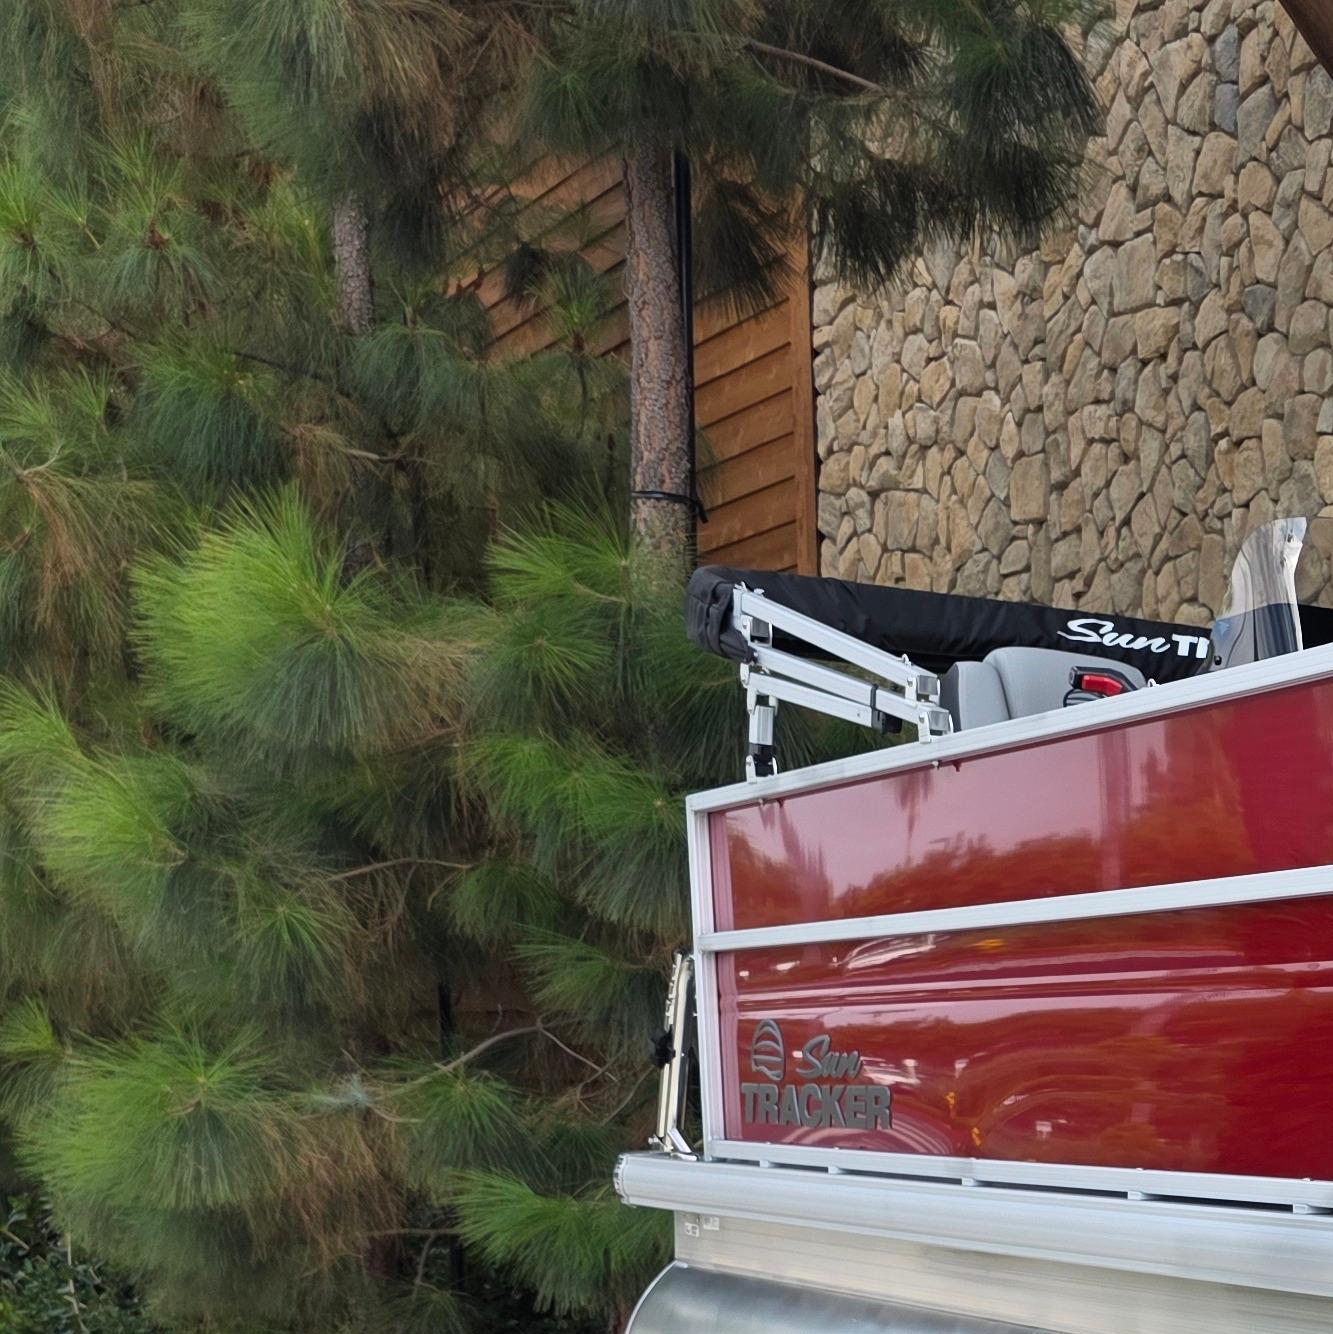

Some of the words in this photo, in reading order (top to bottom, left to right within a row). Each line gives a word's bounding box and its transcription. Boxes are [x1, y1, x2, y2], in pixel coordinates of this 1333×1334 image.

[1056, 618, 1171, 654] Sun
[795, 1033, 864, 1079] Sun
[741, 1082, 893, 1131] TRACKER
